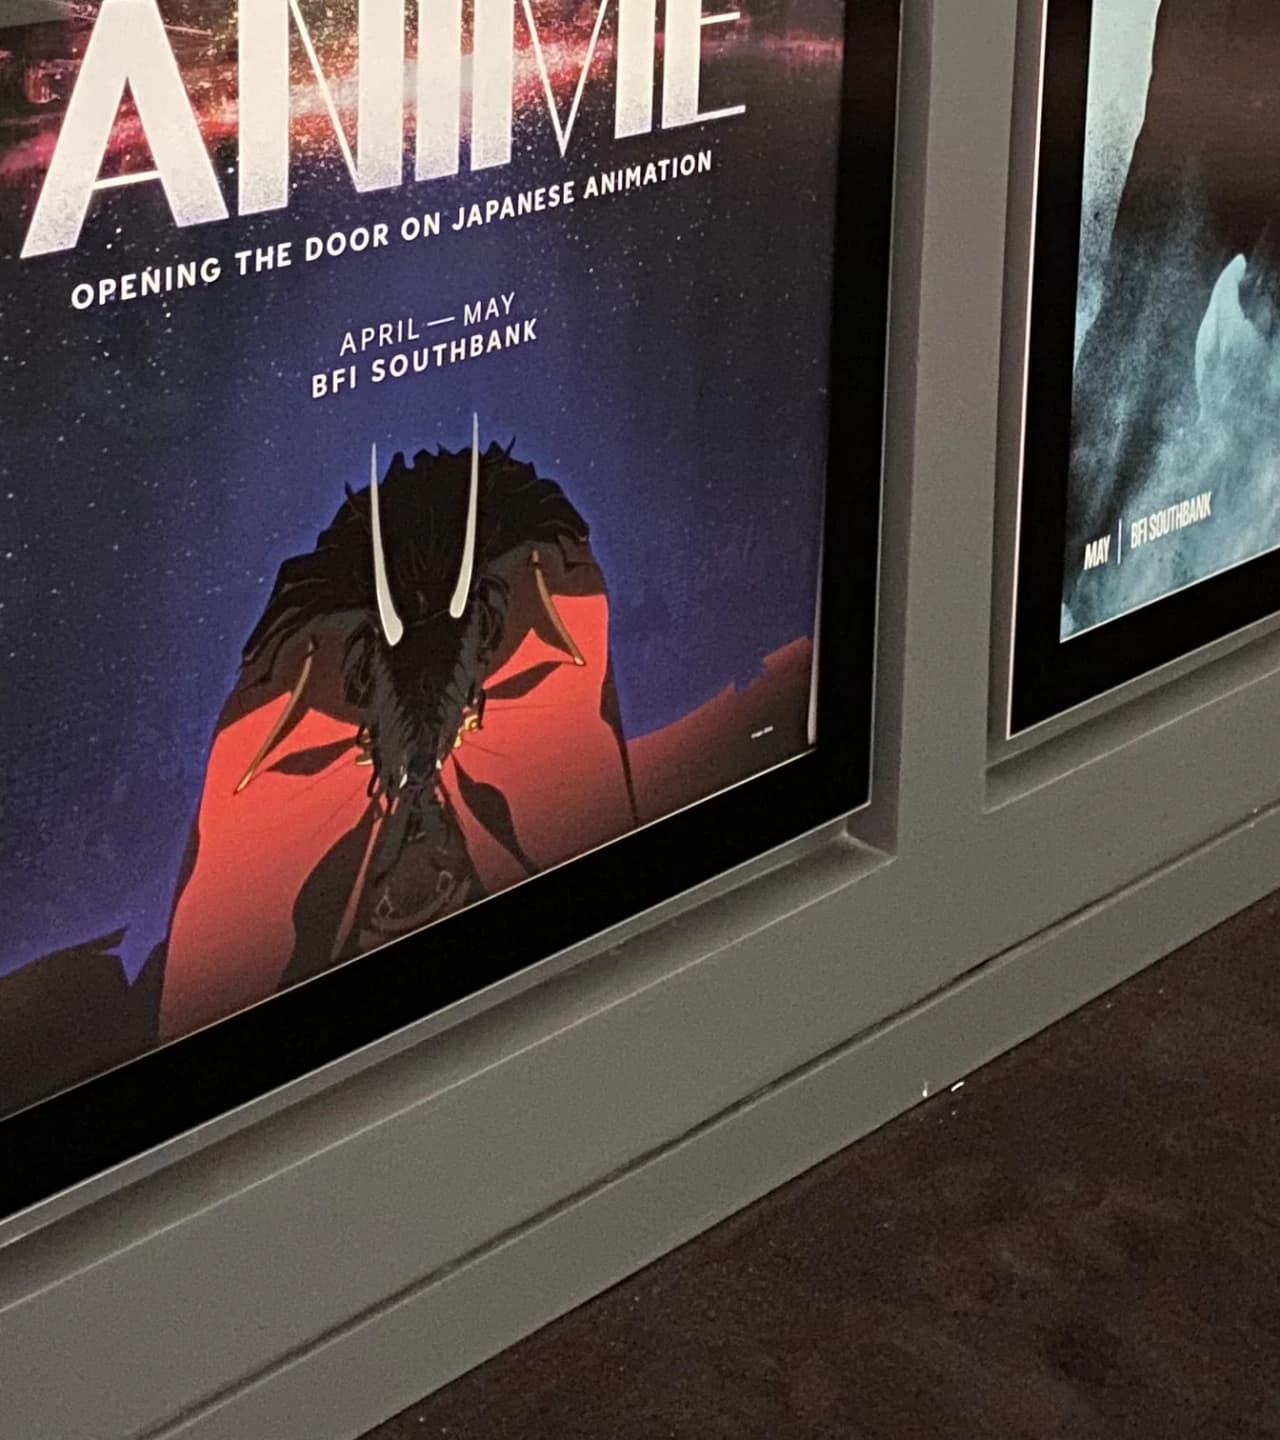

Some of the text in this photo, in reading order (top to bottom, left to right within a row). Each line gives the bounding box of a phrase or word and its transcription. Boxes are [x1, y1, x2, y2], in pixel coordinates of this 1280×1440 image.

[71, 149, 713, 309] OPENING THE DOOR ON JAPANESE ANIMATION
[311, 318, 537, 399] BFI SOUTHBANK
[339, 317, 420, 357] APRIL
[463, 291, 515, 327] MAY
[1083, 491, 1213, 570] MAY BFI SOUTHBANK
